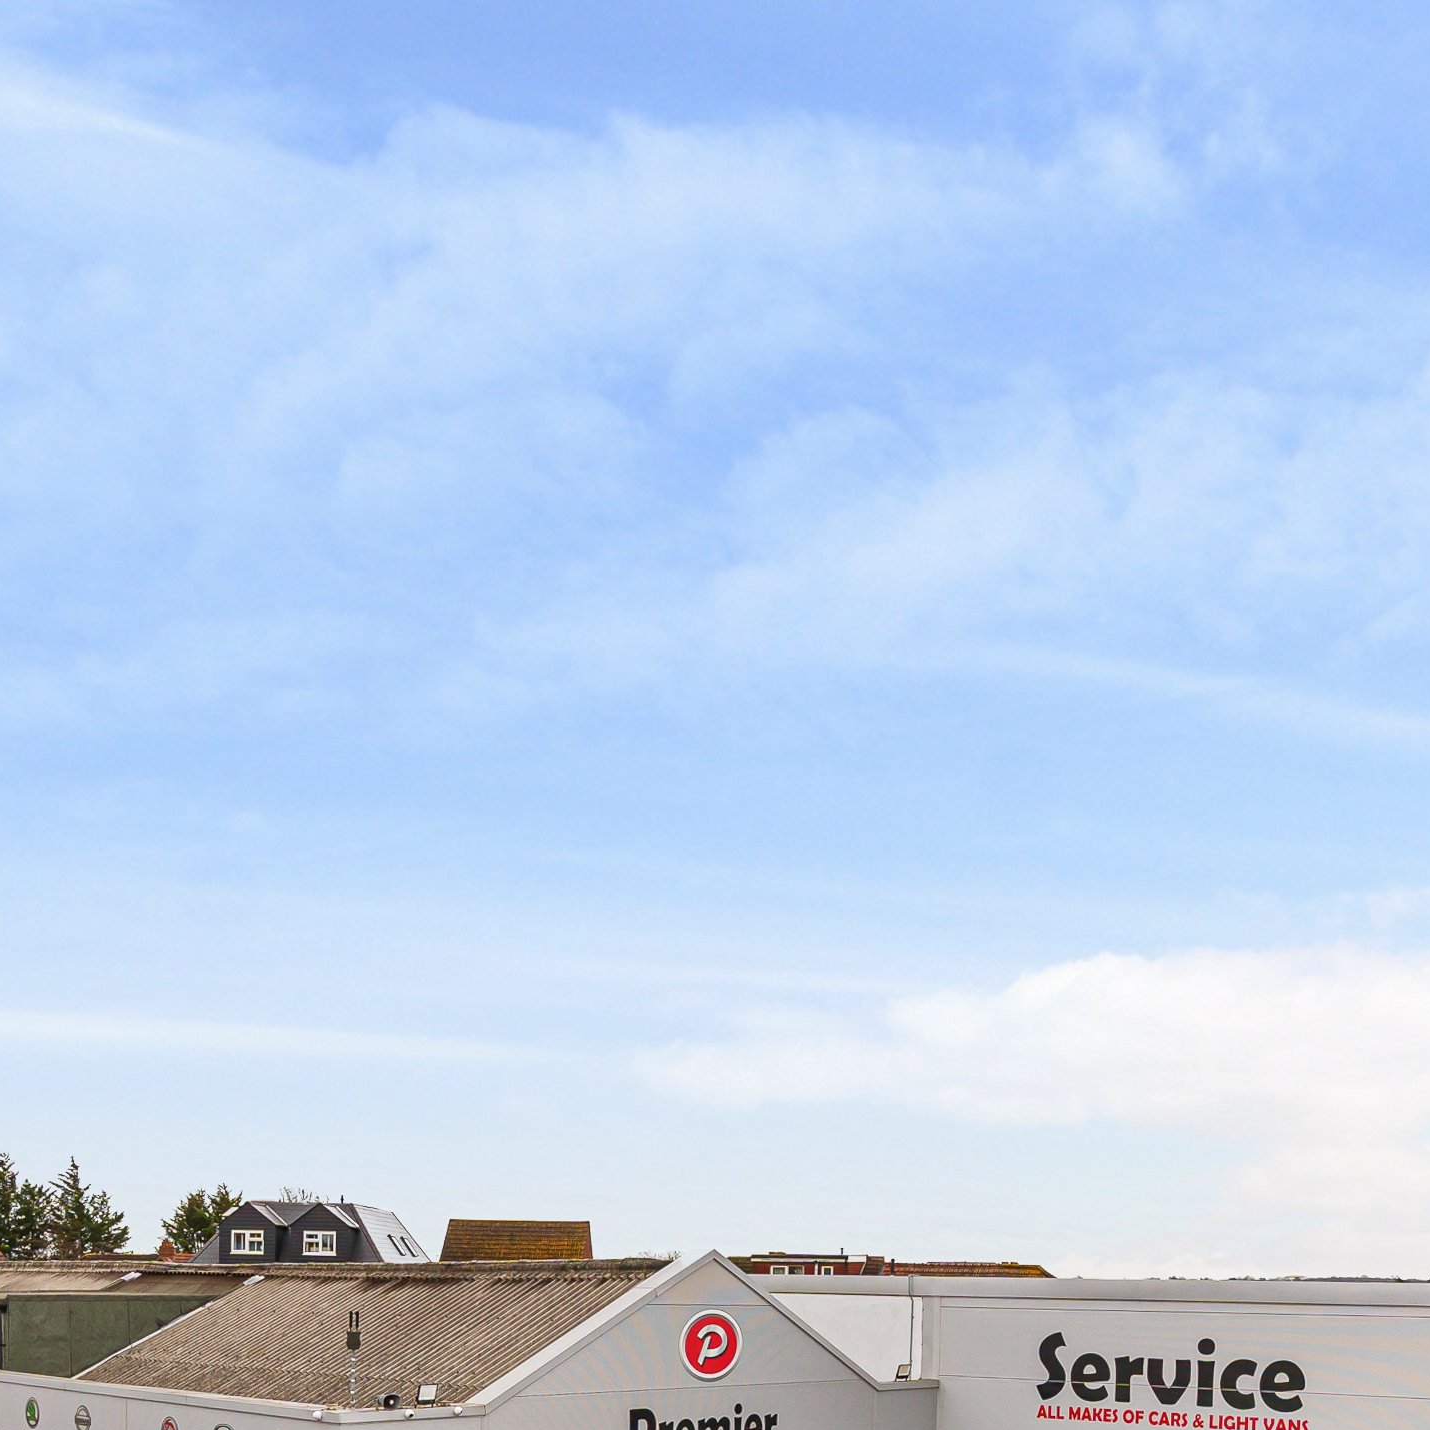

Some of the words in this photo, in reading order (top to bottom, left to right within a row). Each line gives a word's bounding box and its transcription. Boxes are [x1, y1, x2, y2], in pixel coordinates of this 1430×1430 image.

[1035, 1330, 1307, 1414] Service
[1036, 1404, 1065, 1420] ALL
[1068, 1406, 1119, 1423] MAKES
[1123, 1409, 1144, 1425] OF
[1148, 1411, 1189, 1429] CARS
[1192, 1413, 1205, 1430] &
